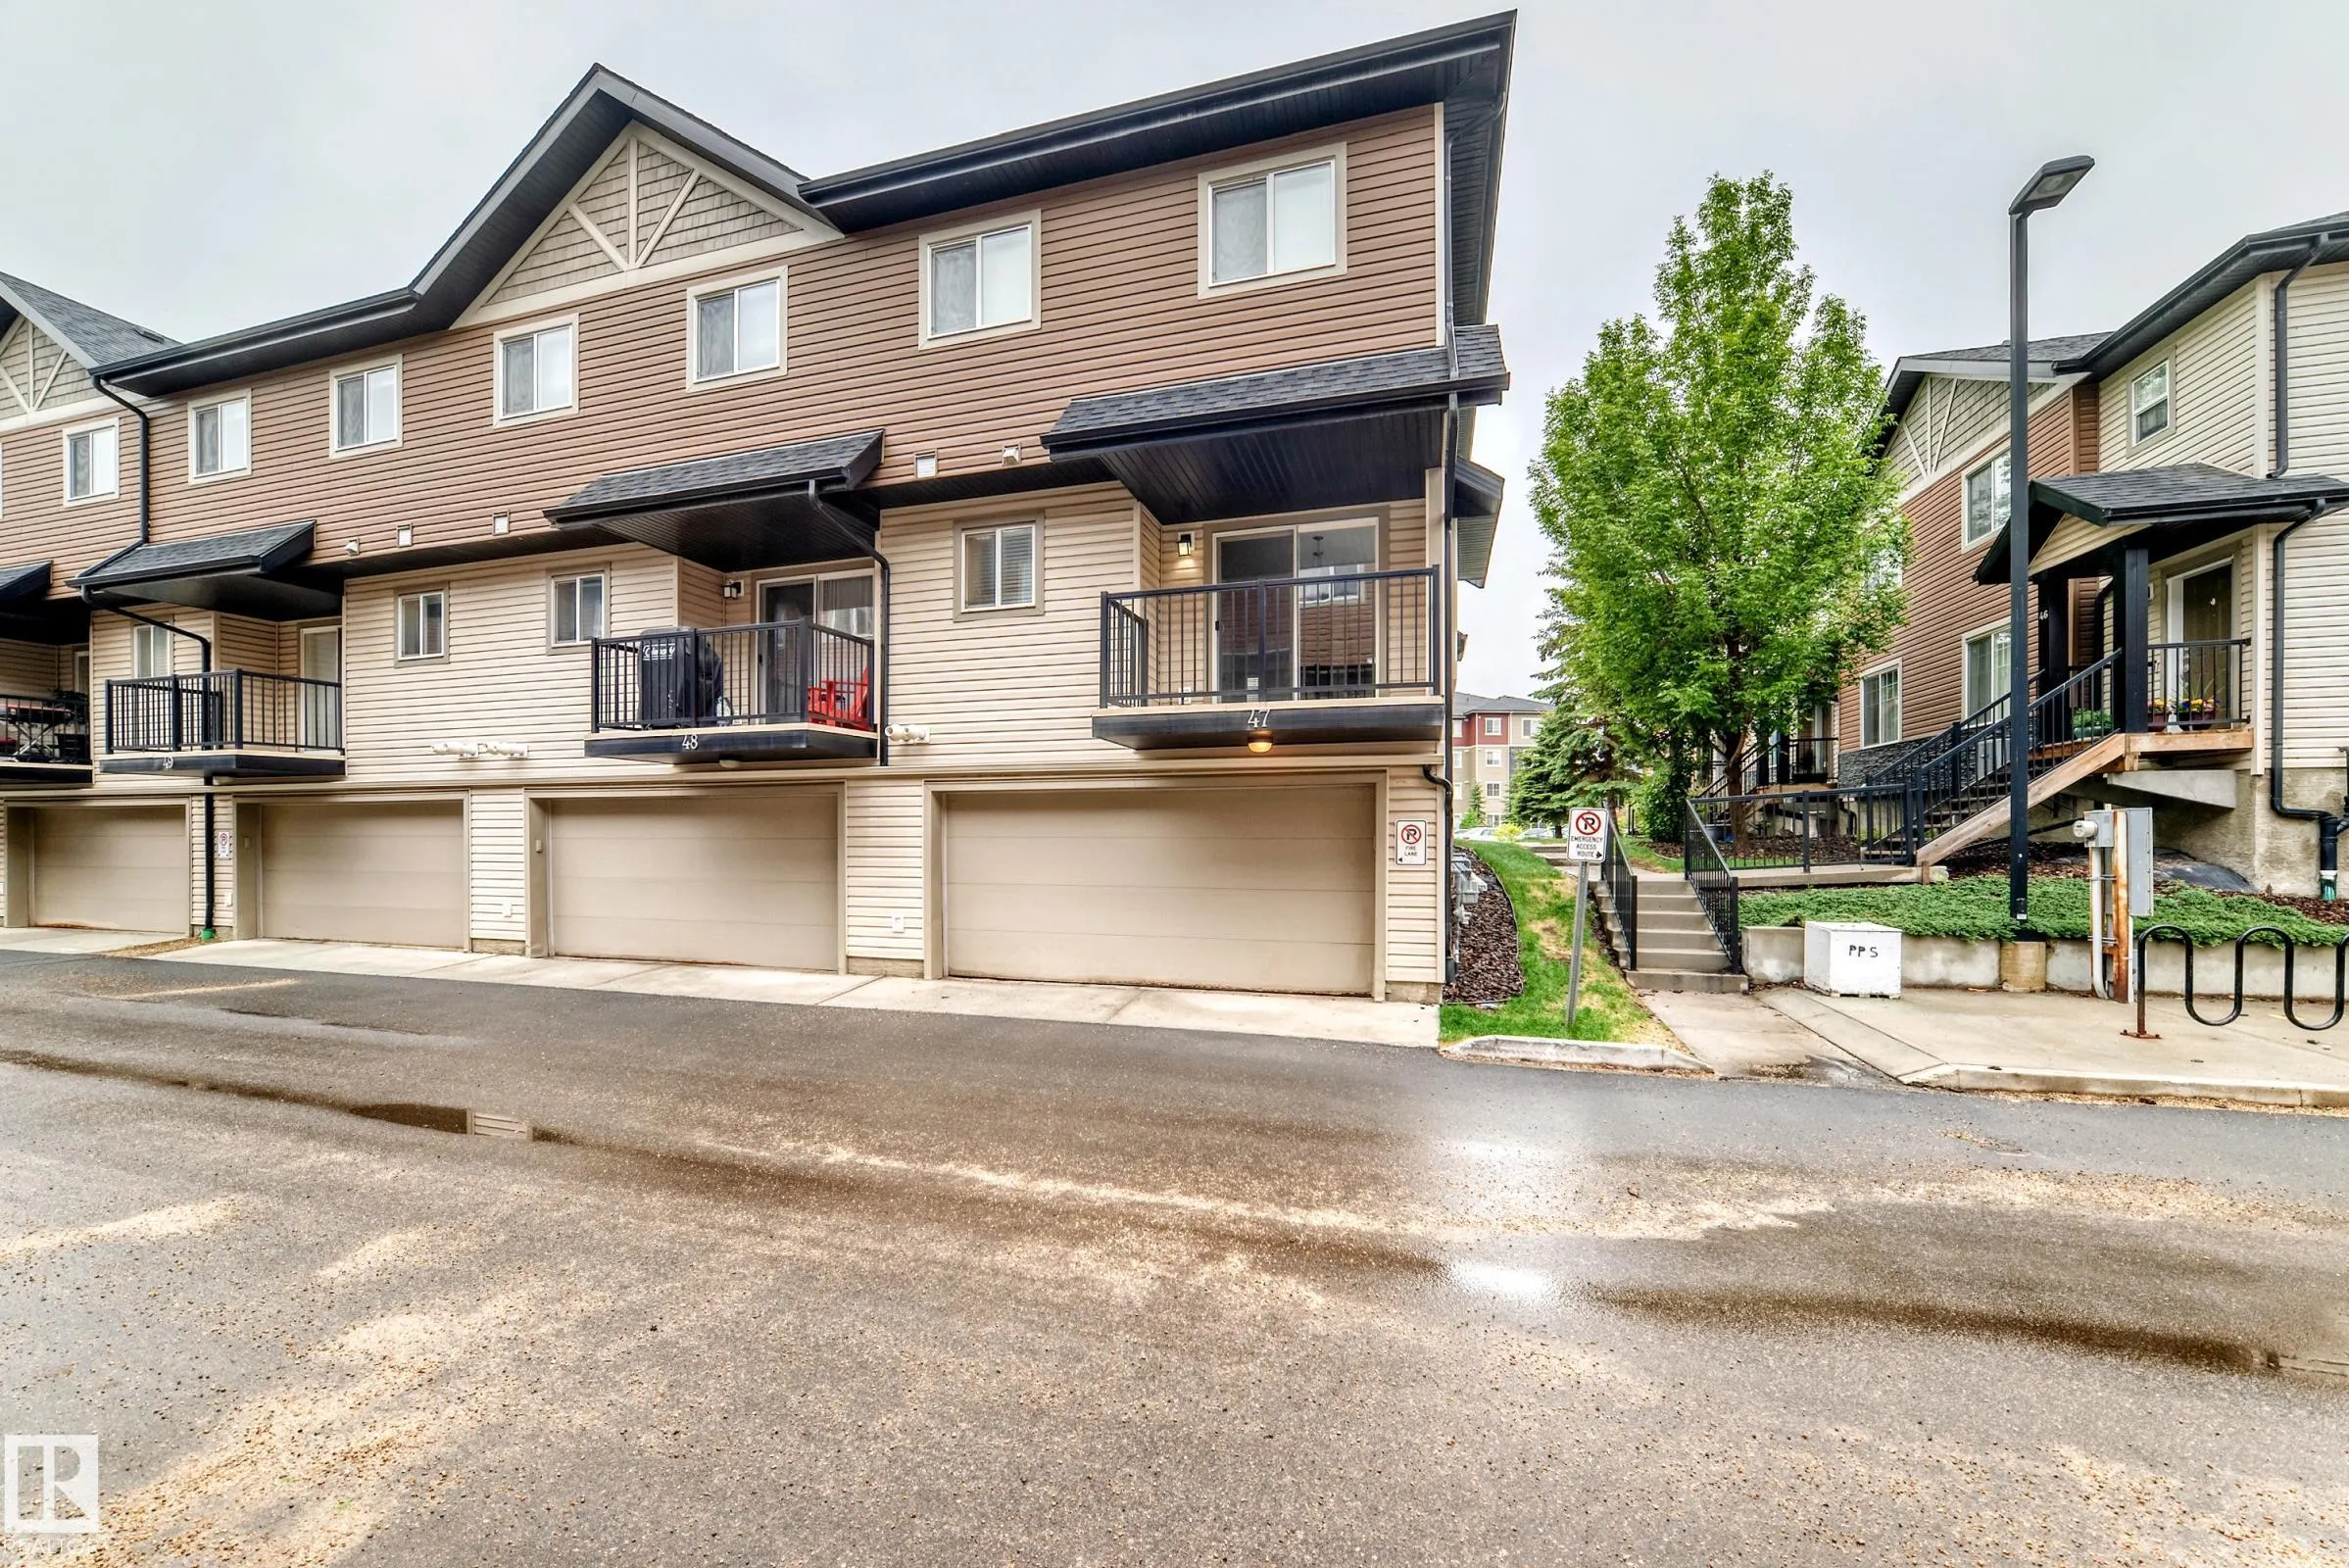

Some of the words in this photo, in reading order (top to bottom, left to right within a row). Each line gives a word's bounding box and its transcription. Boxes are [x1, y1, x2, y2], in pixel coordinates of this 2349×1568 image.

[1248, 708, 1271, 728] 47
[682, 734, 699, 750] 48
[163, 756, 174, 768] 49
